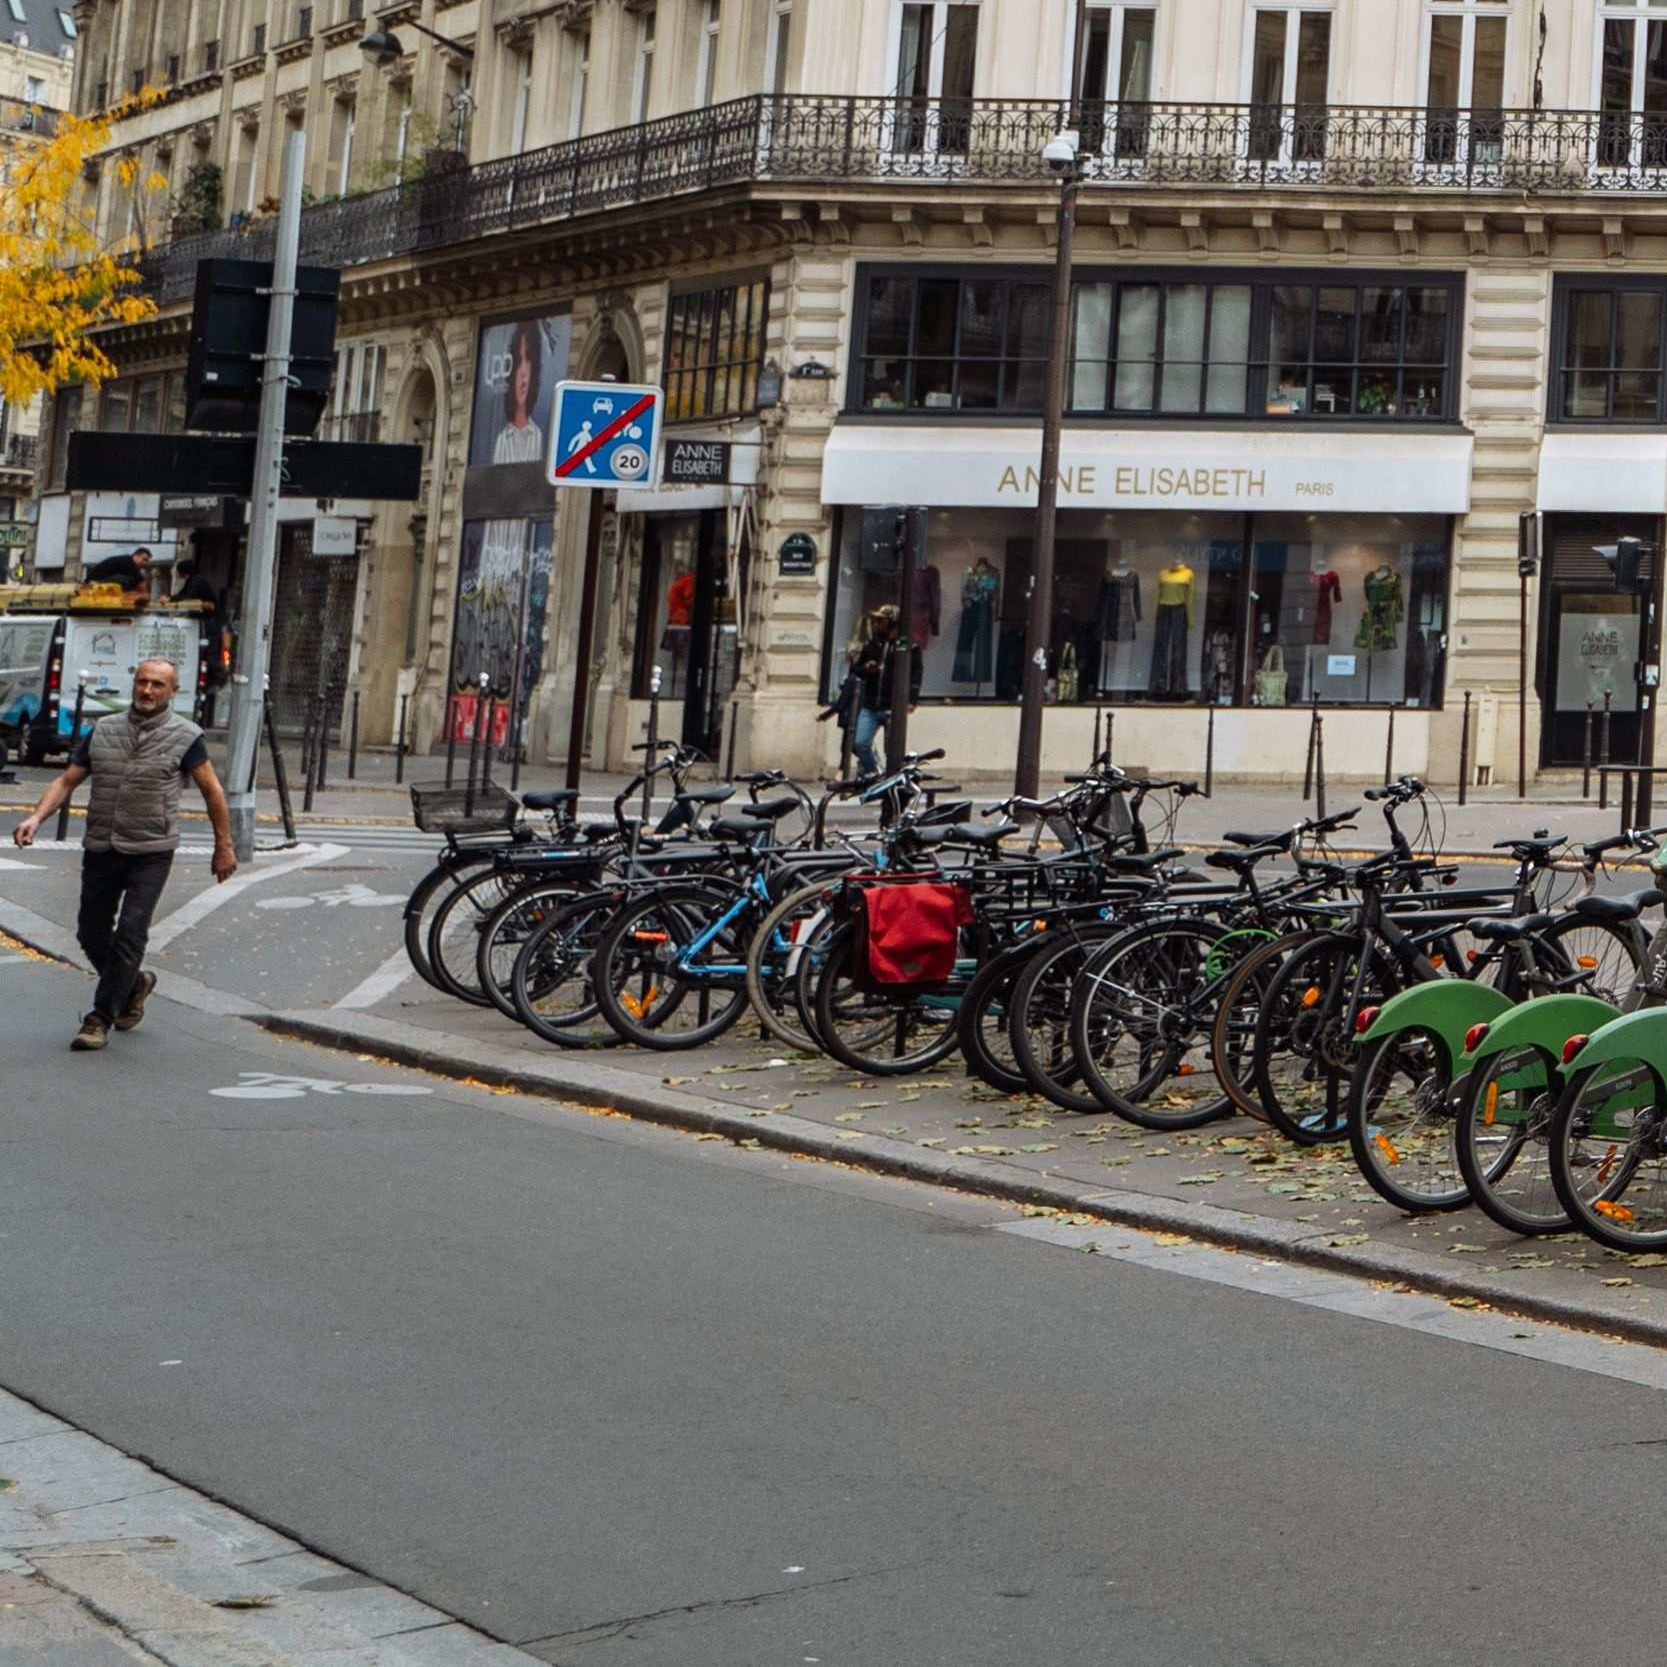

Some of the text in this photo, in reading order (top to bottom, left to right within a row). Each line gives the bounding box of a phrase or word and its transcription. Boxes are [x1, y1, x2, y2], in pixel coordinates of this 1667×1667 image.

[674, 444, 722, 460] ANNE
[619, 456, 640, 469] 20
[672, 460, 722, 475] ELISABETH
[997, 466, 1335, 497] ANNE ELISABETH PARIS
[1582, 632, 1618, 643] ANNE
[1581, 644, 1619, 656] ELISABETH
